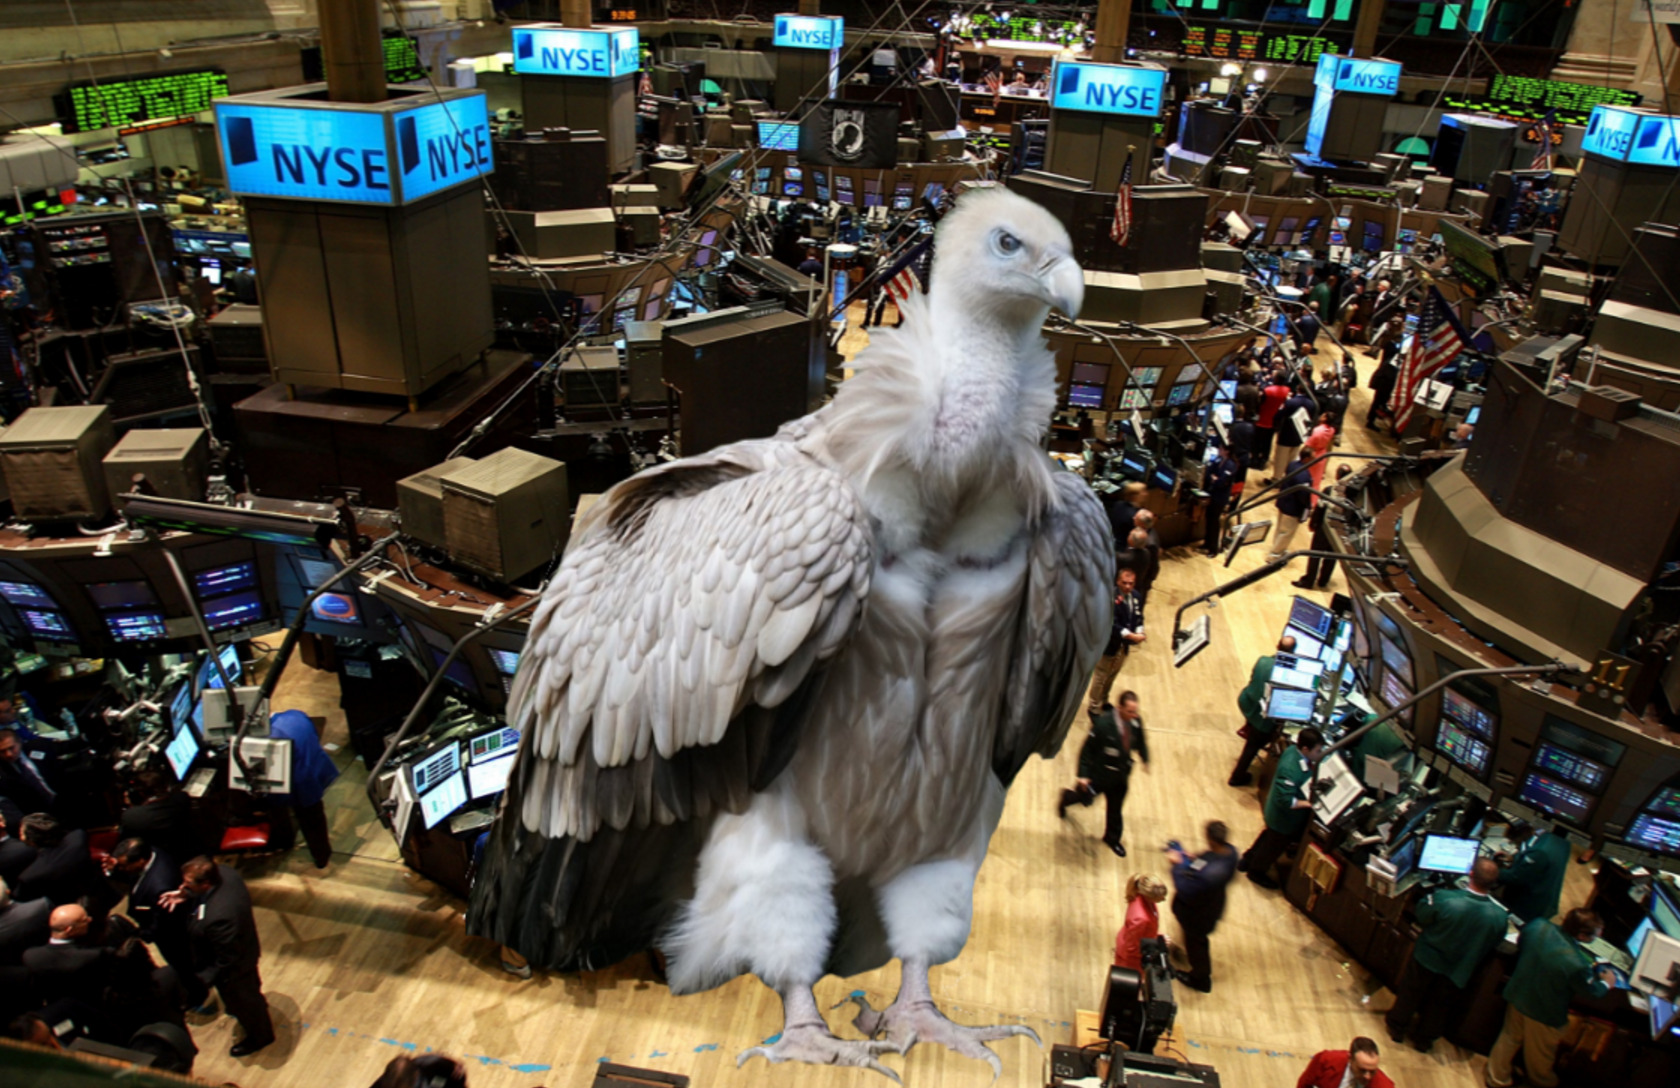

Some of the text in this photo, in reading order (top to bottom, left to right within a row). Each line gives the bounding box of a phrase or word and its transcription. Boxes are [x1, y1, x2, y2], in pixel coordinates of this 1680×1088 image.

[791, 29, 830, 45] NYSE
[541, 47, 605, 72] NYSE
[1353, 73, 1396, 90] NYSE
[1085, 82, 1156, 111] NYSE
[426, 124, 489, 182] NYSE
[1595, 127, 1630, 153] NYSE
[271, 143, 390, 190] NYSE
[1592, 659, 1631, 690] 11
